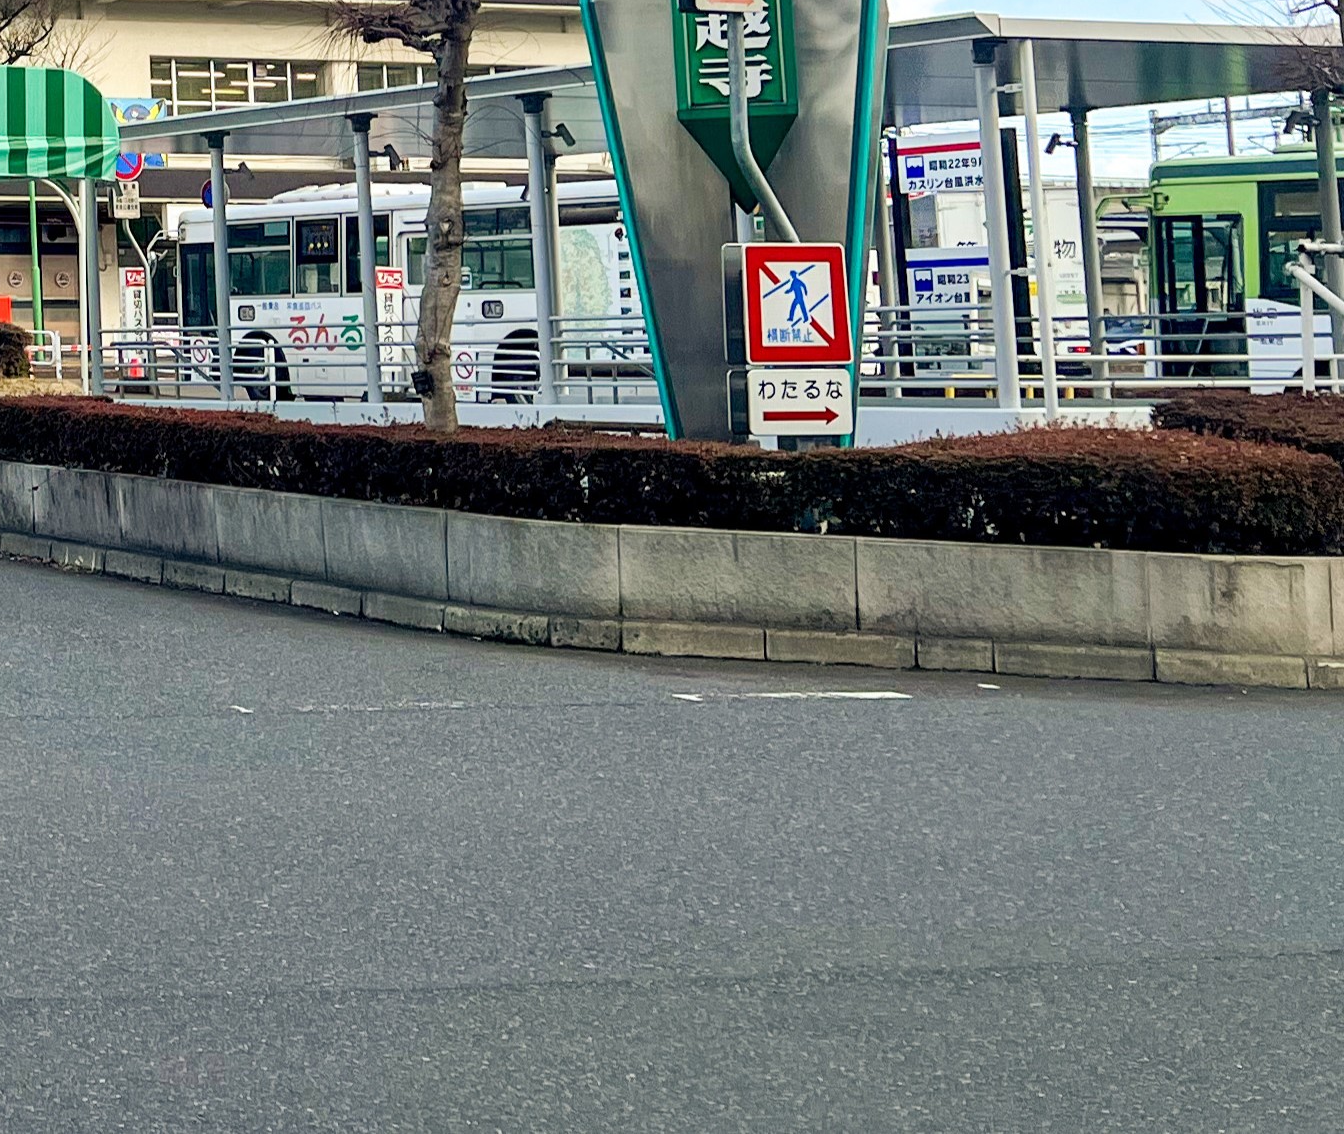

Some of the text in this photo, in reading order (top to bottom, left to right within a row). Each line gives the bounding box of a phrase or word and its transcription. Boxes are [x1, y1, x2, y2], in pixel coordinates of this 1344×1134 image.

[485, 303, 501, 316] 入口
[767, 328, 814, 343] 横断禁止
[758, 379, 843, 400] わたるな
